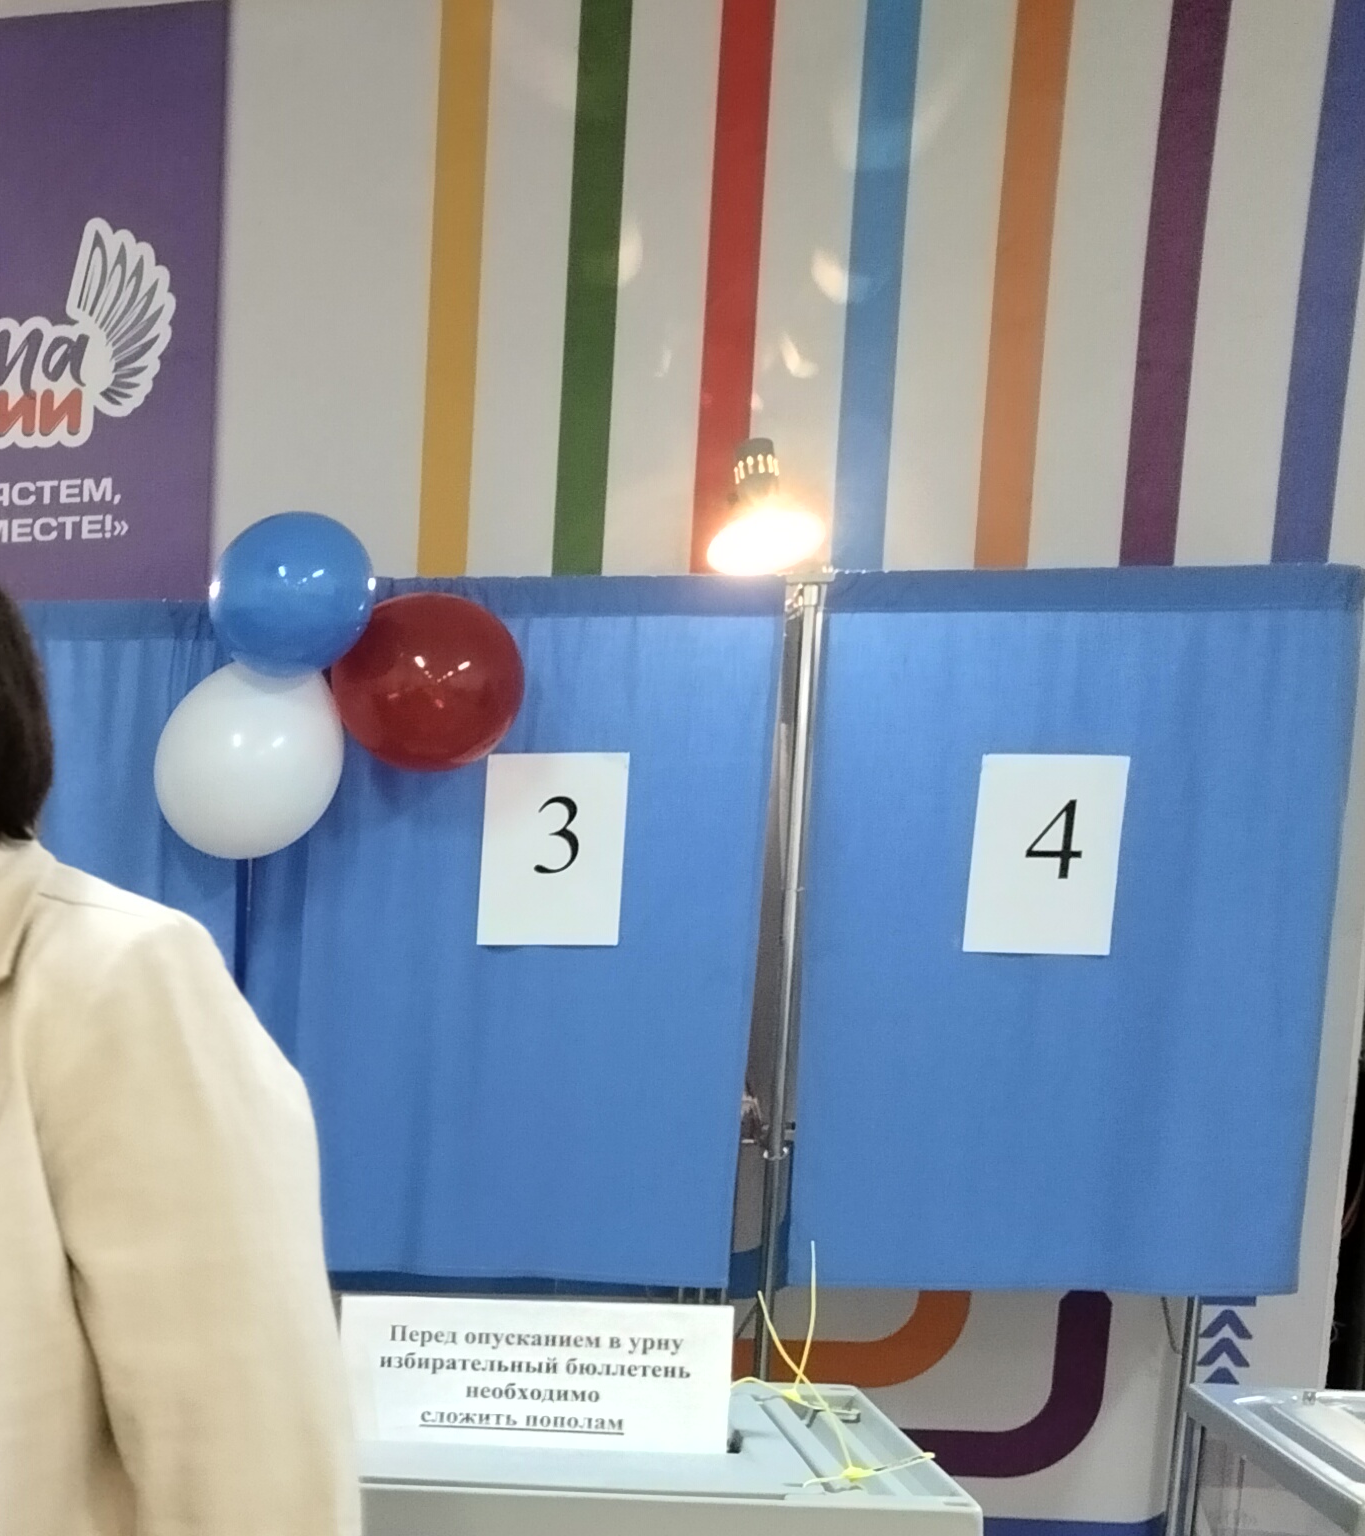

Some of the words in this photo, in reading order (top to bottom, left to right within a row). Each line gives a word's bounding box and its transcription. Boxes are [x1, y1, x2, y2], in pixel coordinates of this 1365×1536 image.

[533, 795, 580, 875] 3
[1024, 798, 1083, 879] 4
[389, 1324, 458, 1347] Перед
[464, 1331, 601, 1350] опусканием
[609, 1336, 621, 1349] в
[628, 1337, 685, 1355] урну
[379, 1352, 559, 1375] избирательный
[565, 1358, 691, 1379] бюллетень
[466, 1383, 601, 1404] необходимо
[420, 1410, 518, 1427] сложить
[525, 1414, 624, 1431] пополам
